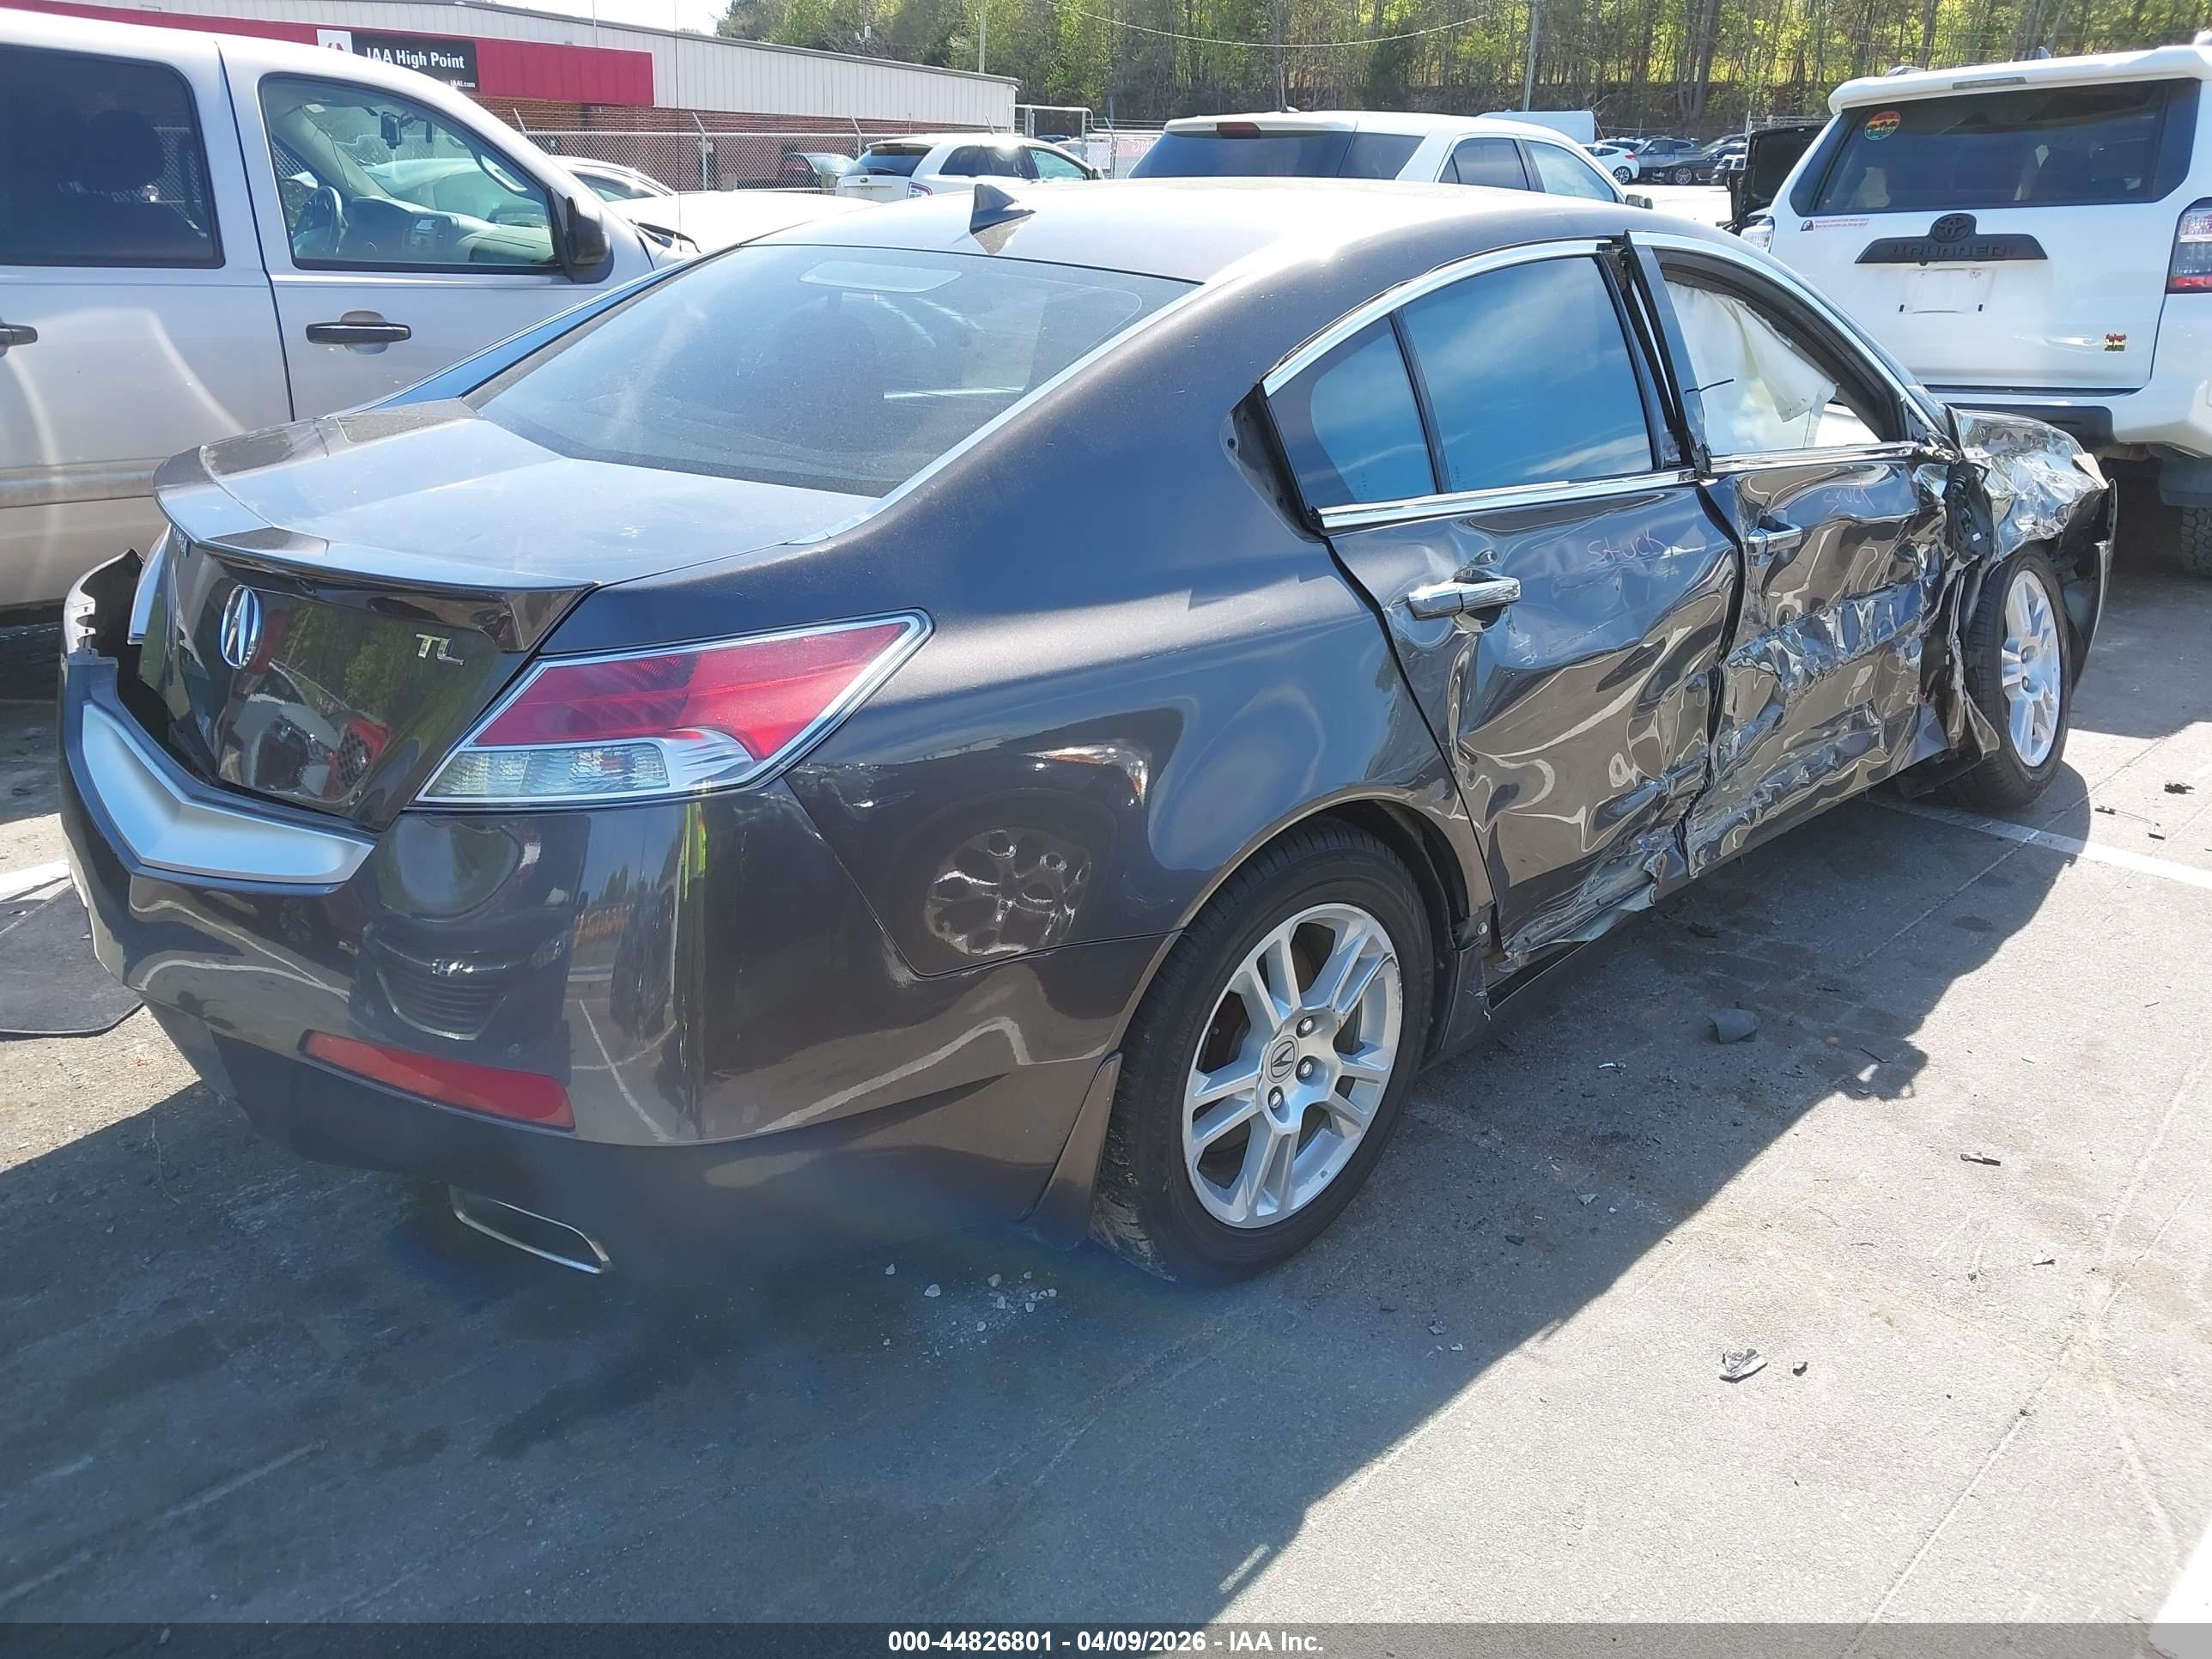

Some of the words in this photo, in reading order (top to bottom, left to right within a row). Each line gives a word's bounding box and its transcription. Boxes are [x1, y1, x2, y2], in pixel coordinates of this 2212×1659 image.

[366, 47, 394, 64] IAA
[396, 49, 428, 69] High
[429, 52, 465, 70] Point
[415, 633, 465, 666] TL
